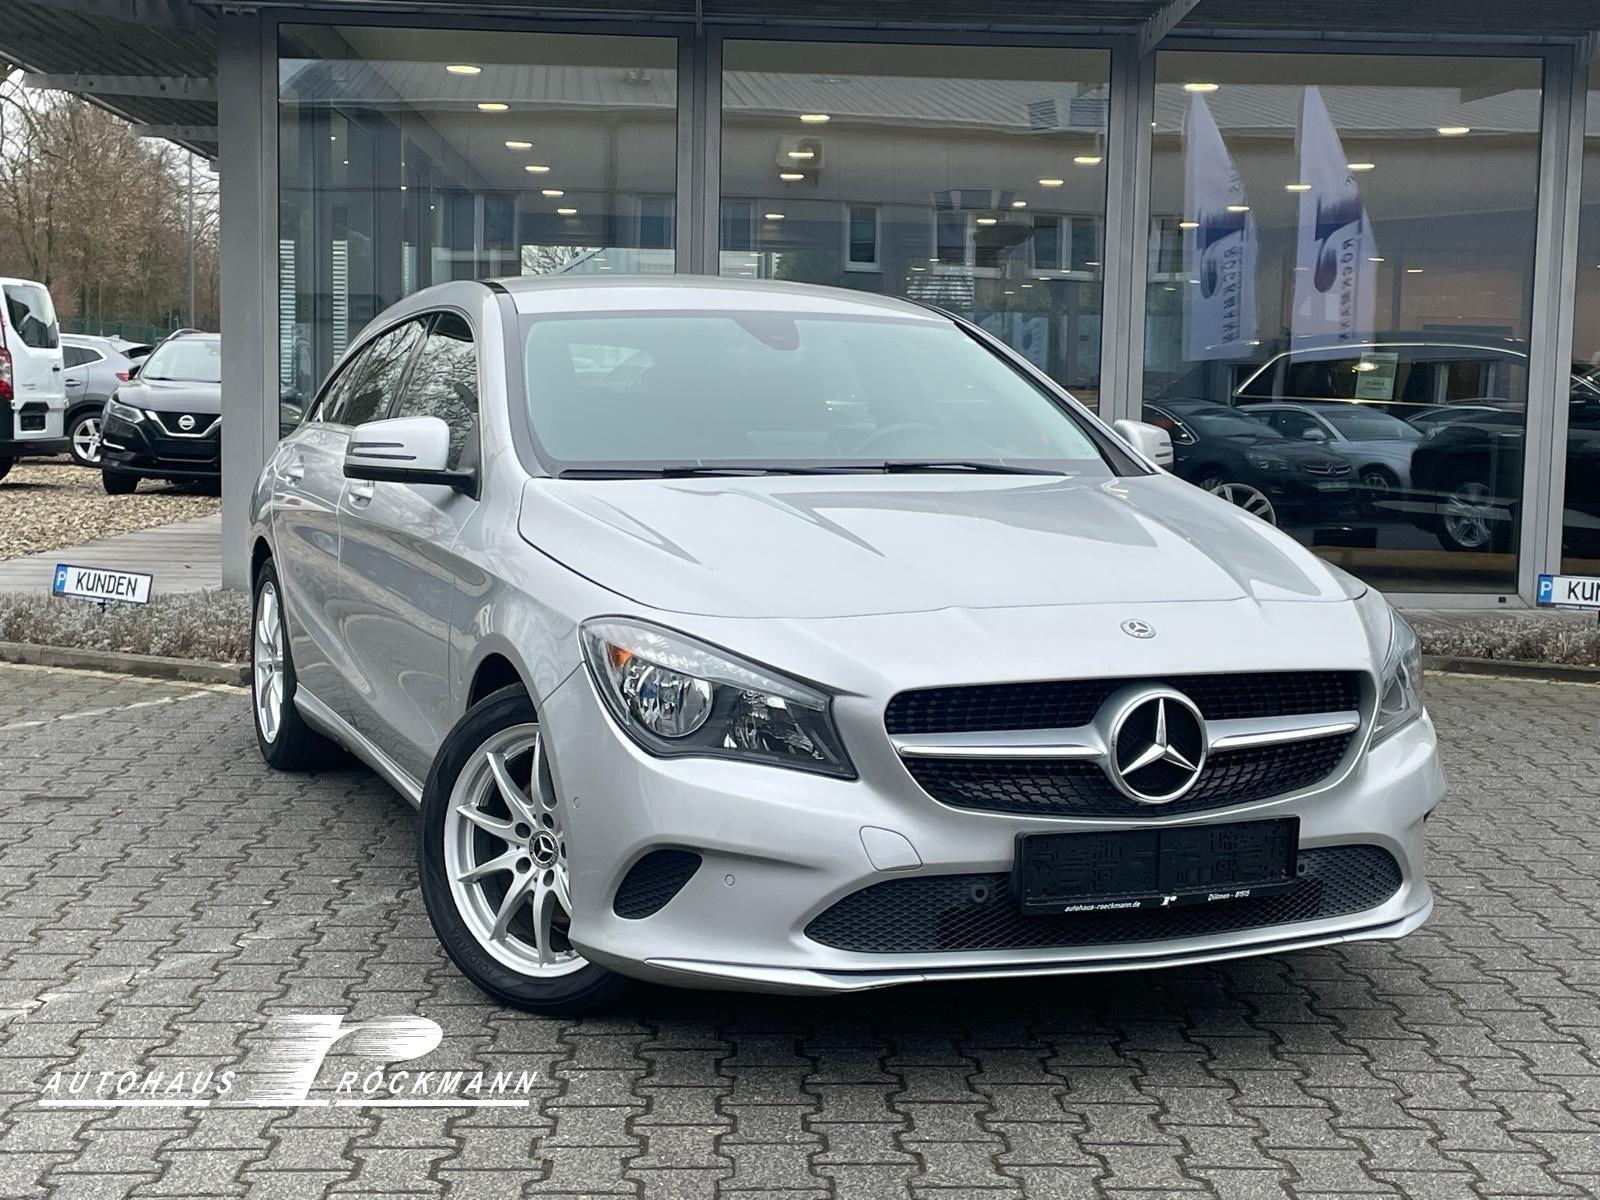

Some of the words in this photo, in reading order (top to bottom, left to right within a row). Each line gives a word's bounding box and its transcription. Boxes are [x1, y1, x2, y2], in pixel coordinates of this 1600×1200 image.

[56, 571, 66, 586] P
[76, 571, 138, 597] KUNDEN
[1540, 581, 1552, 597] P
